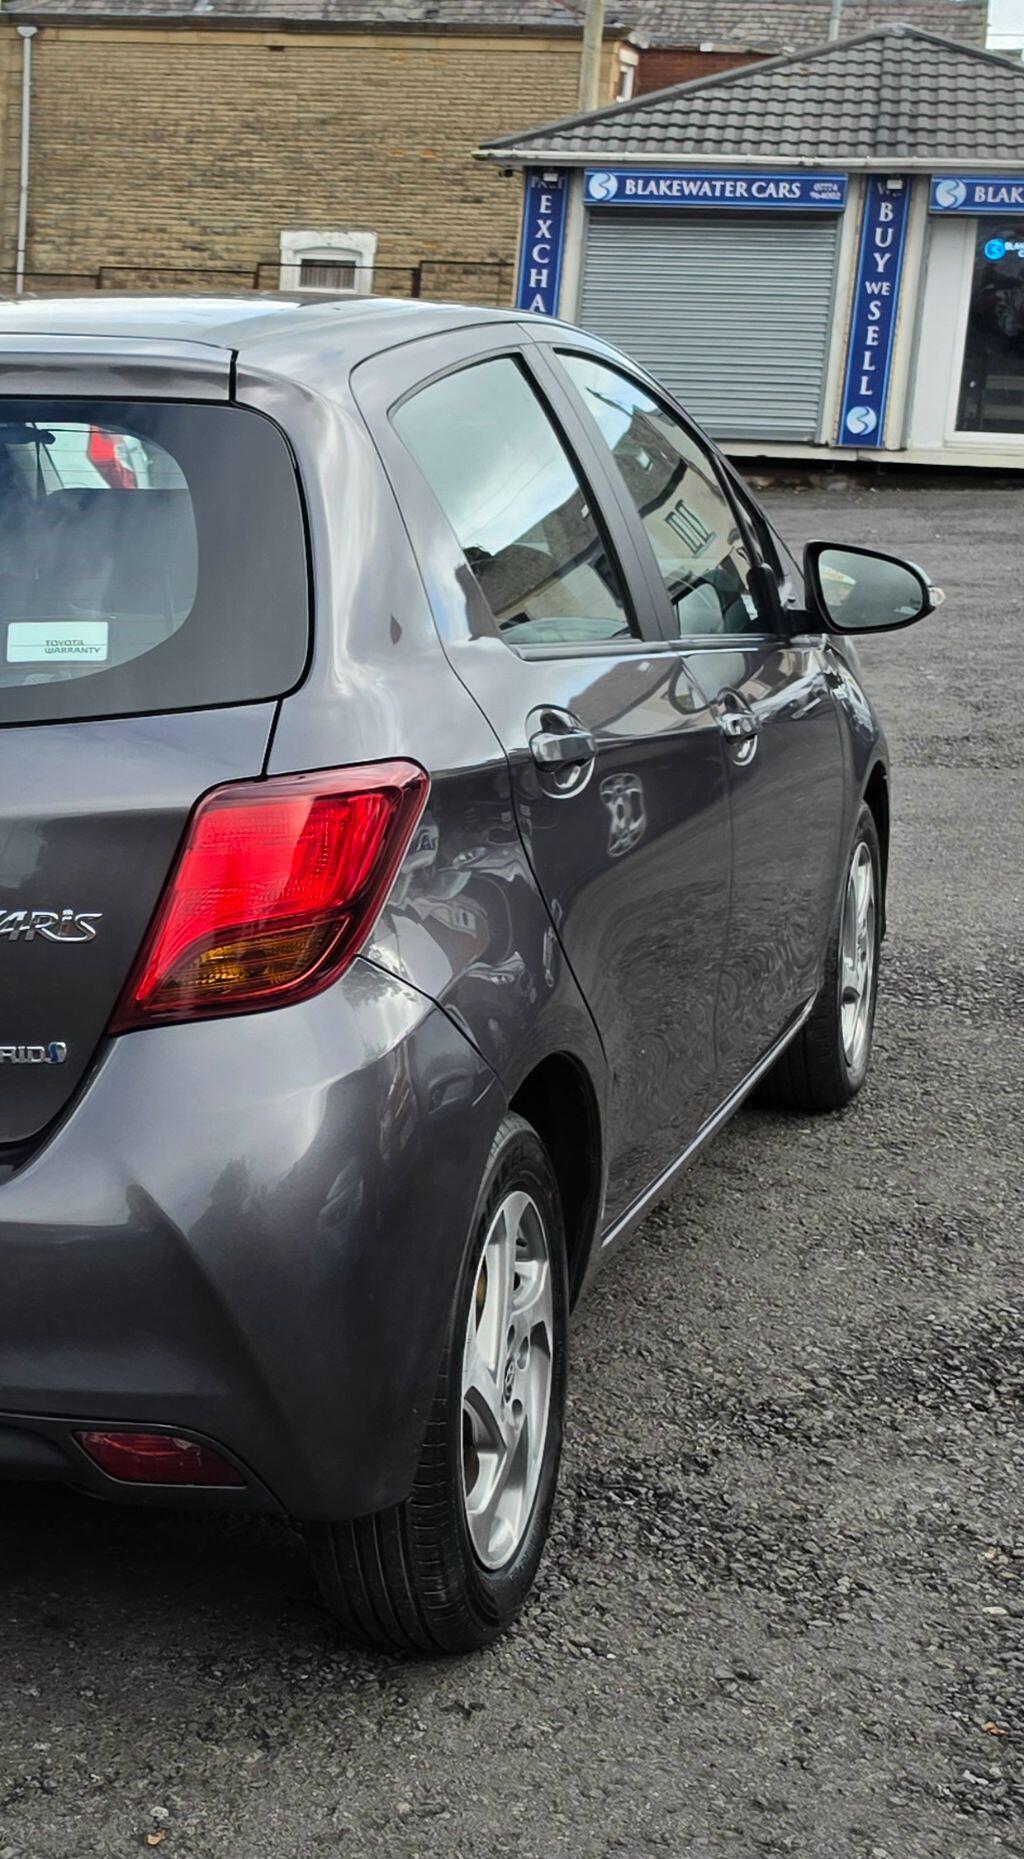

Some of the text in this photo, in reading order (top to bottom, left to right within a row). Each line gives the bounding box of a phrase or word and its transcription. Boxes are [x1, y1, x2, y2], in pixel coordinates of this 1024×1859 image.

[625, 179, 801, 199] BLAKEWATER CARS
[974, 186, 1024, 204] BLAK
[873, 201, 894, 273] BUY
[864, 280, 891, 296] WE
[859, 300, 882, 396] SELL
[44, 639, 85, 647] TOYOTA
[44, 646, 101, 655] WARRANTY
